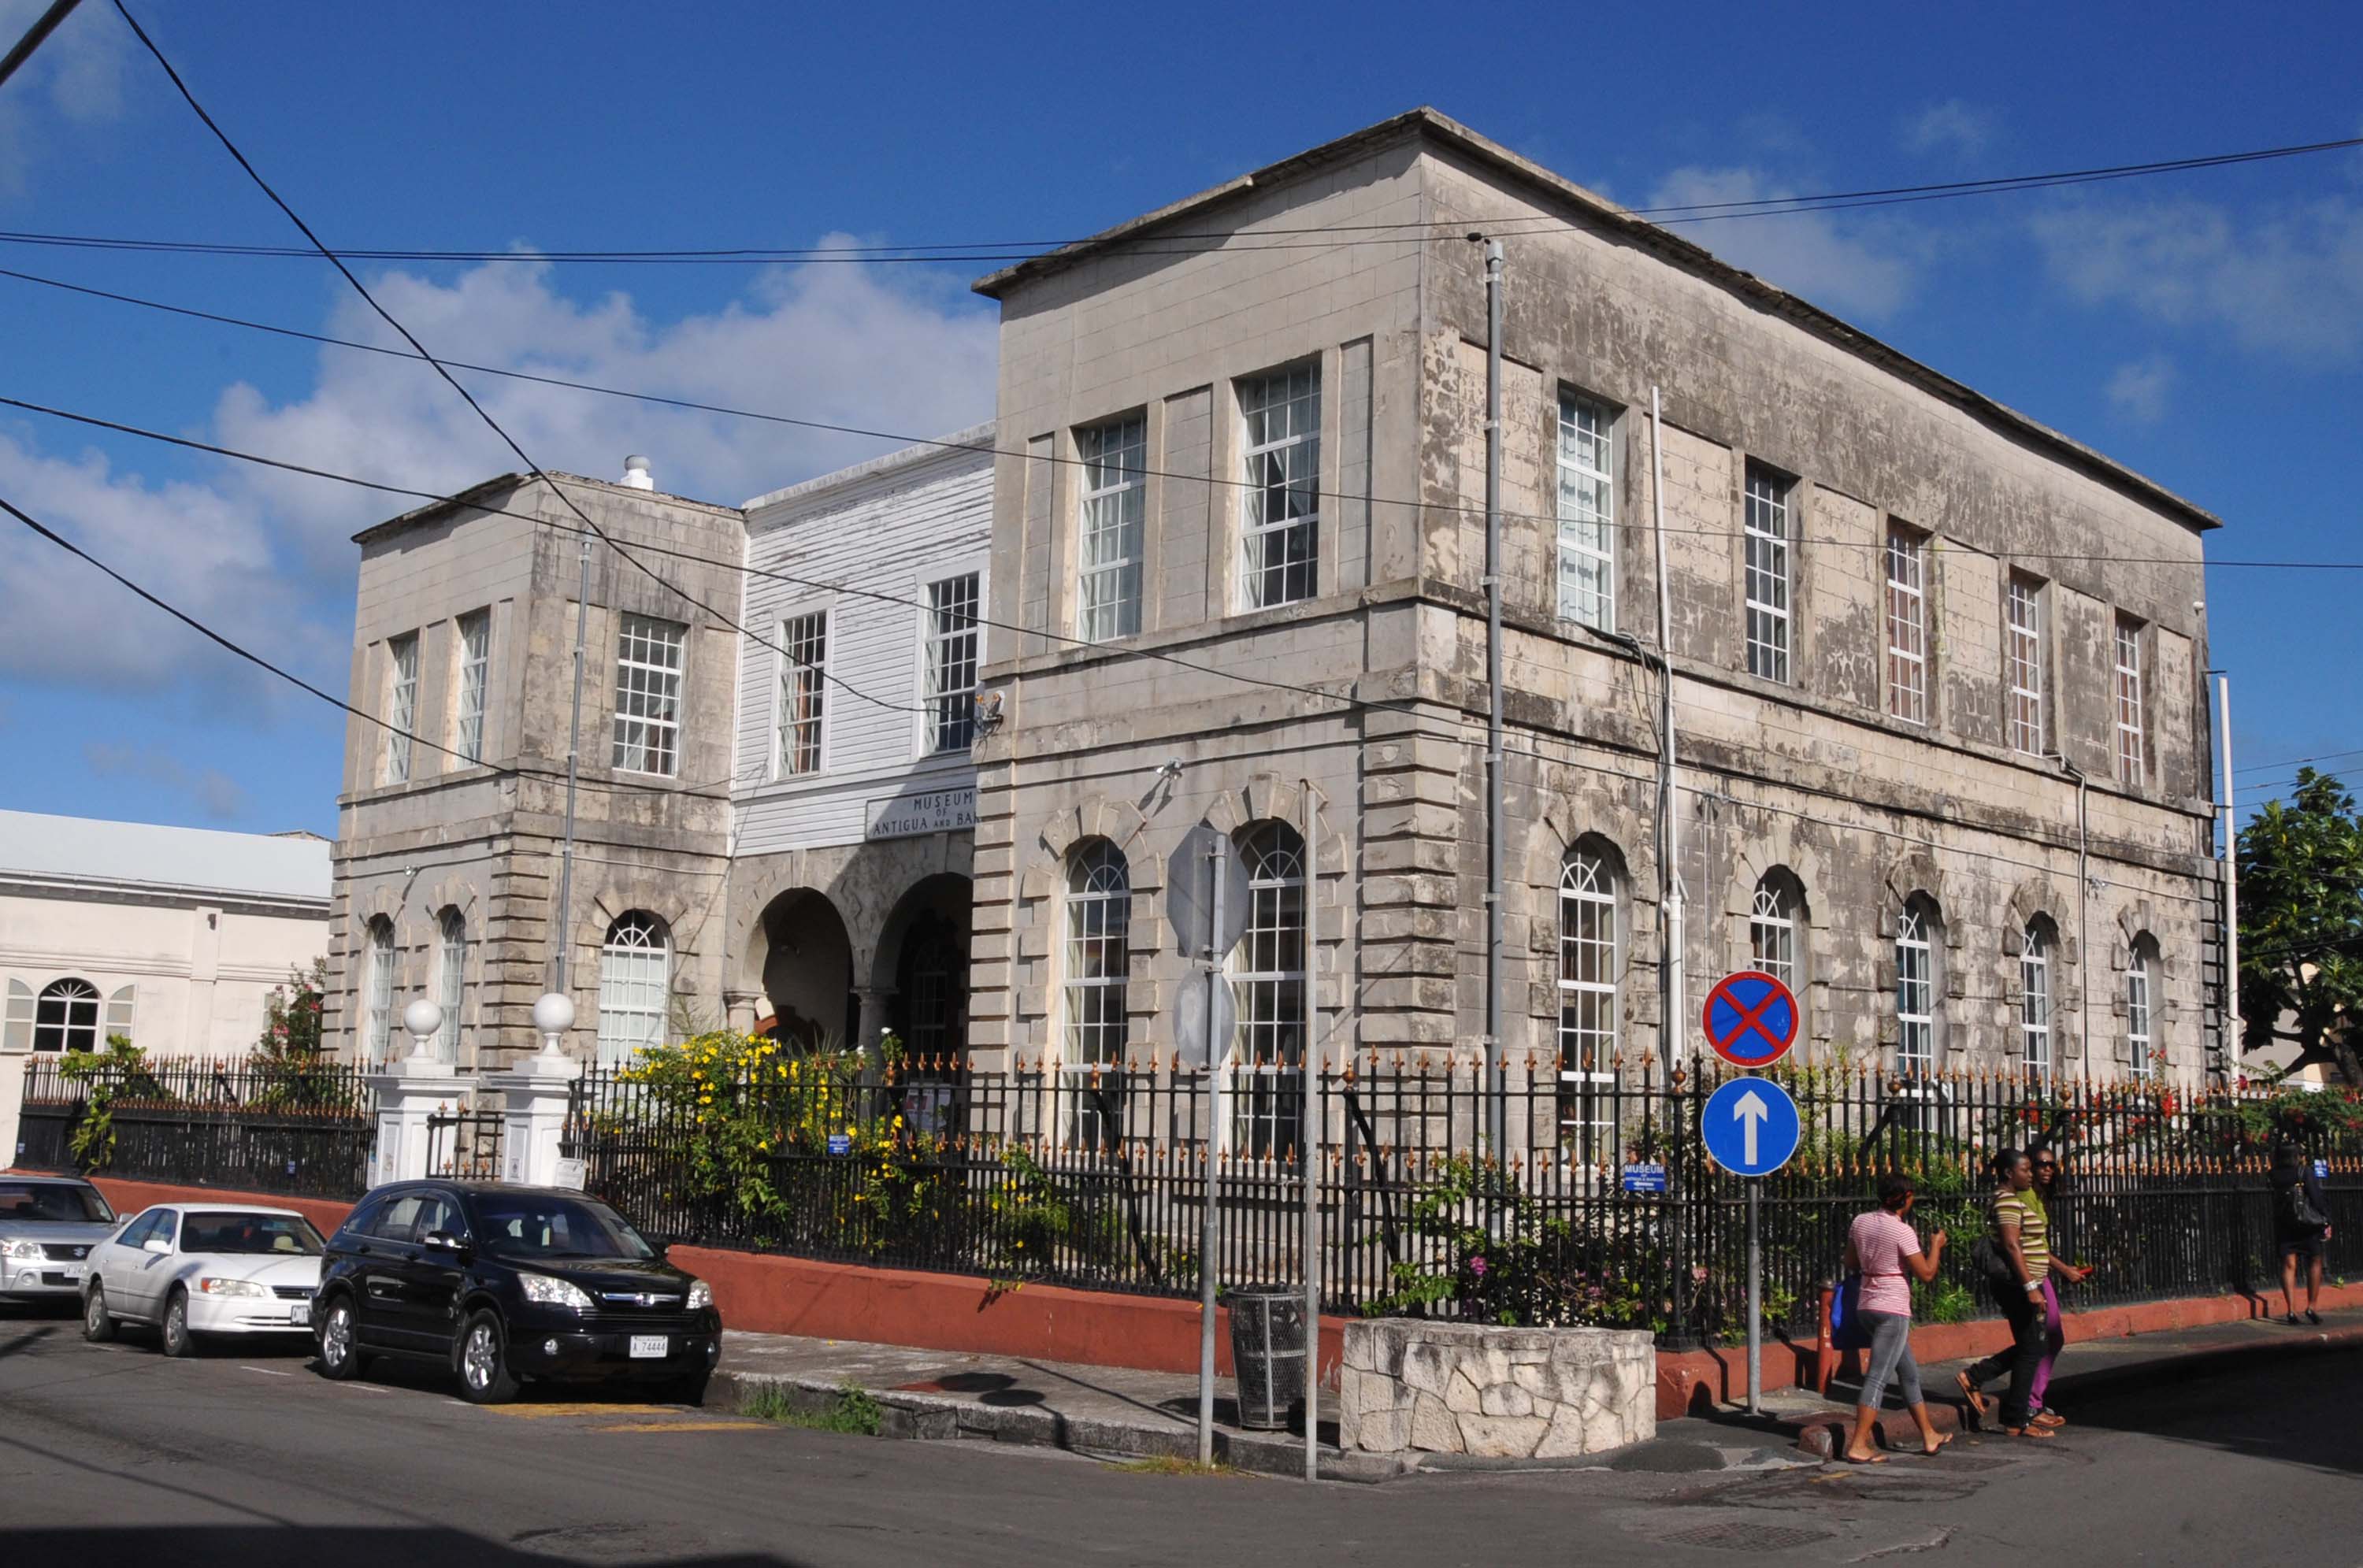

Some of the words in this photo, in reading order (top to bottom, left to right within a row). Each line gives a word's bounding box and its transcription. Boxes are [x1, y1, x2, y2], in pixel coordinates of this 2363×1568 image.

[914, 791, 972, 810] MUSEUM
[874, 817, 927, 835] ANTIGUA
[1625, 1165, 1664, 1173] MUSEUM
[642, 1342, 666, 1351] 74444
